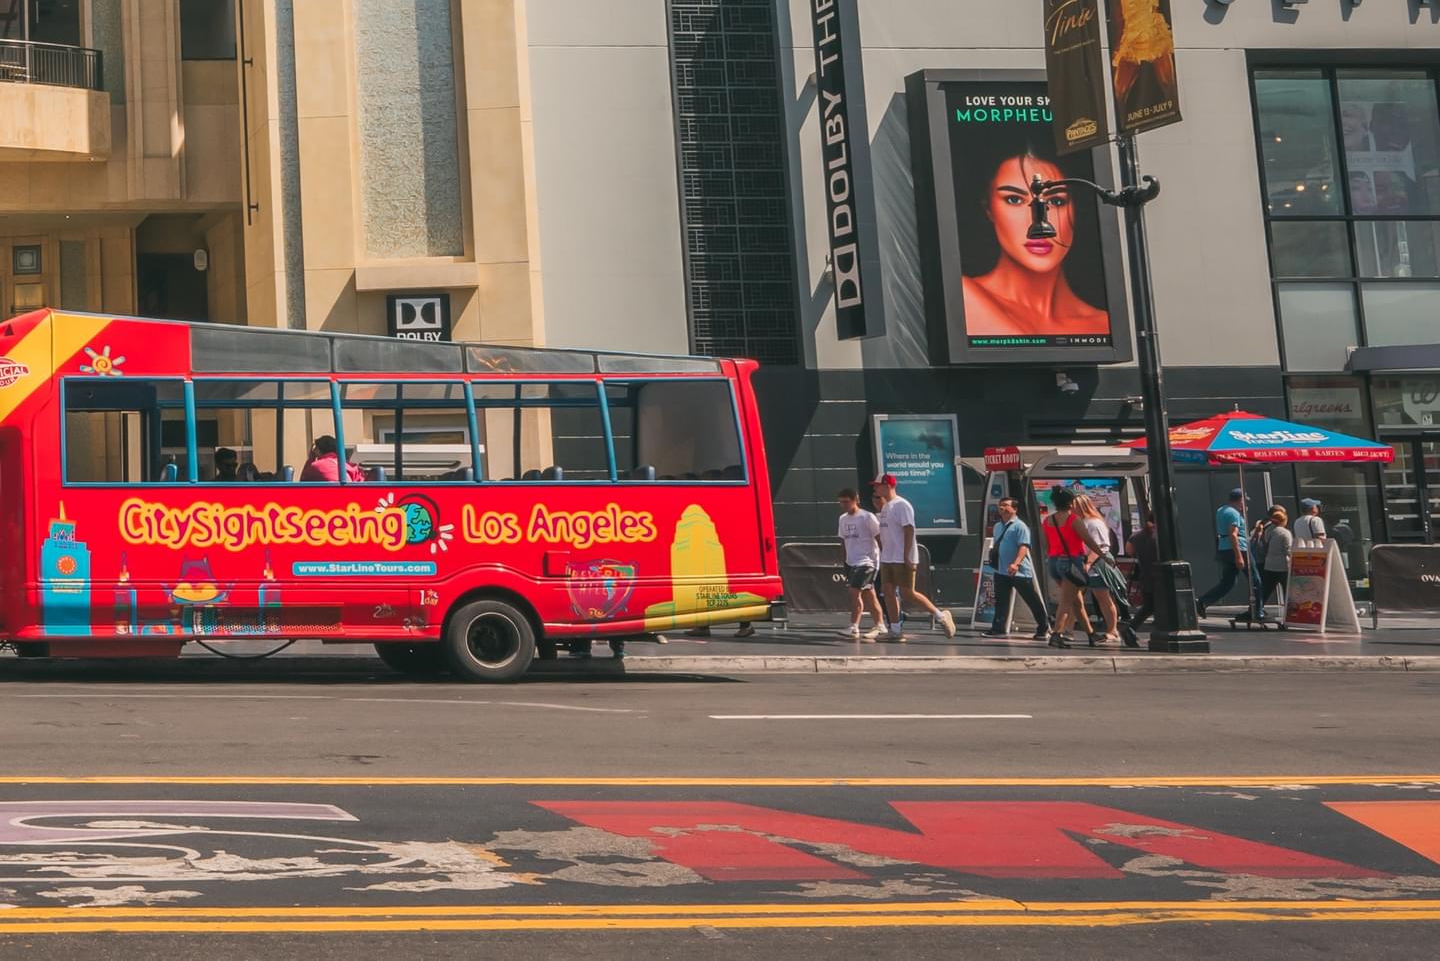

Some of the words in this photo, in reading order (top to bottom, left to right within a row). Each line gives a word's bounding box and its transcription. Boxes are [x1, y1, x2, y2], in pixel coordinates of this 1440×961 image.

[1045, 0, 1096, 47] Tina
[966, 96, 995, 106] LOVE
[1000, 96, 1032, 106] YOUR
[956, 109, 1053, 122] MORPHEU
[1127, 109, 1145, 121] JUNE
[823, 90, 852, 237] DOLBY
[984, 454, 1002, 464] TICKET
[1003, 453, 1019, 463] BOOTH
[119, 497, 408, 551] CitySightseeing
[462, 503, 522, 545] Los
[527, 502, 657, 549] Angeles
[298, 563, 431, 573] www.StarLineTours.com
